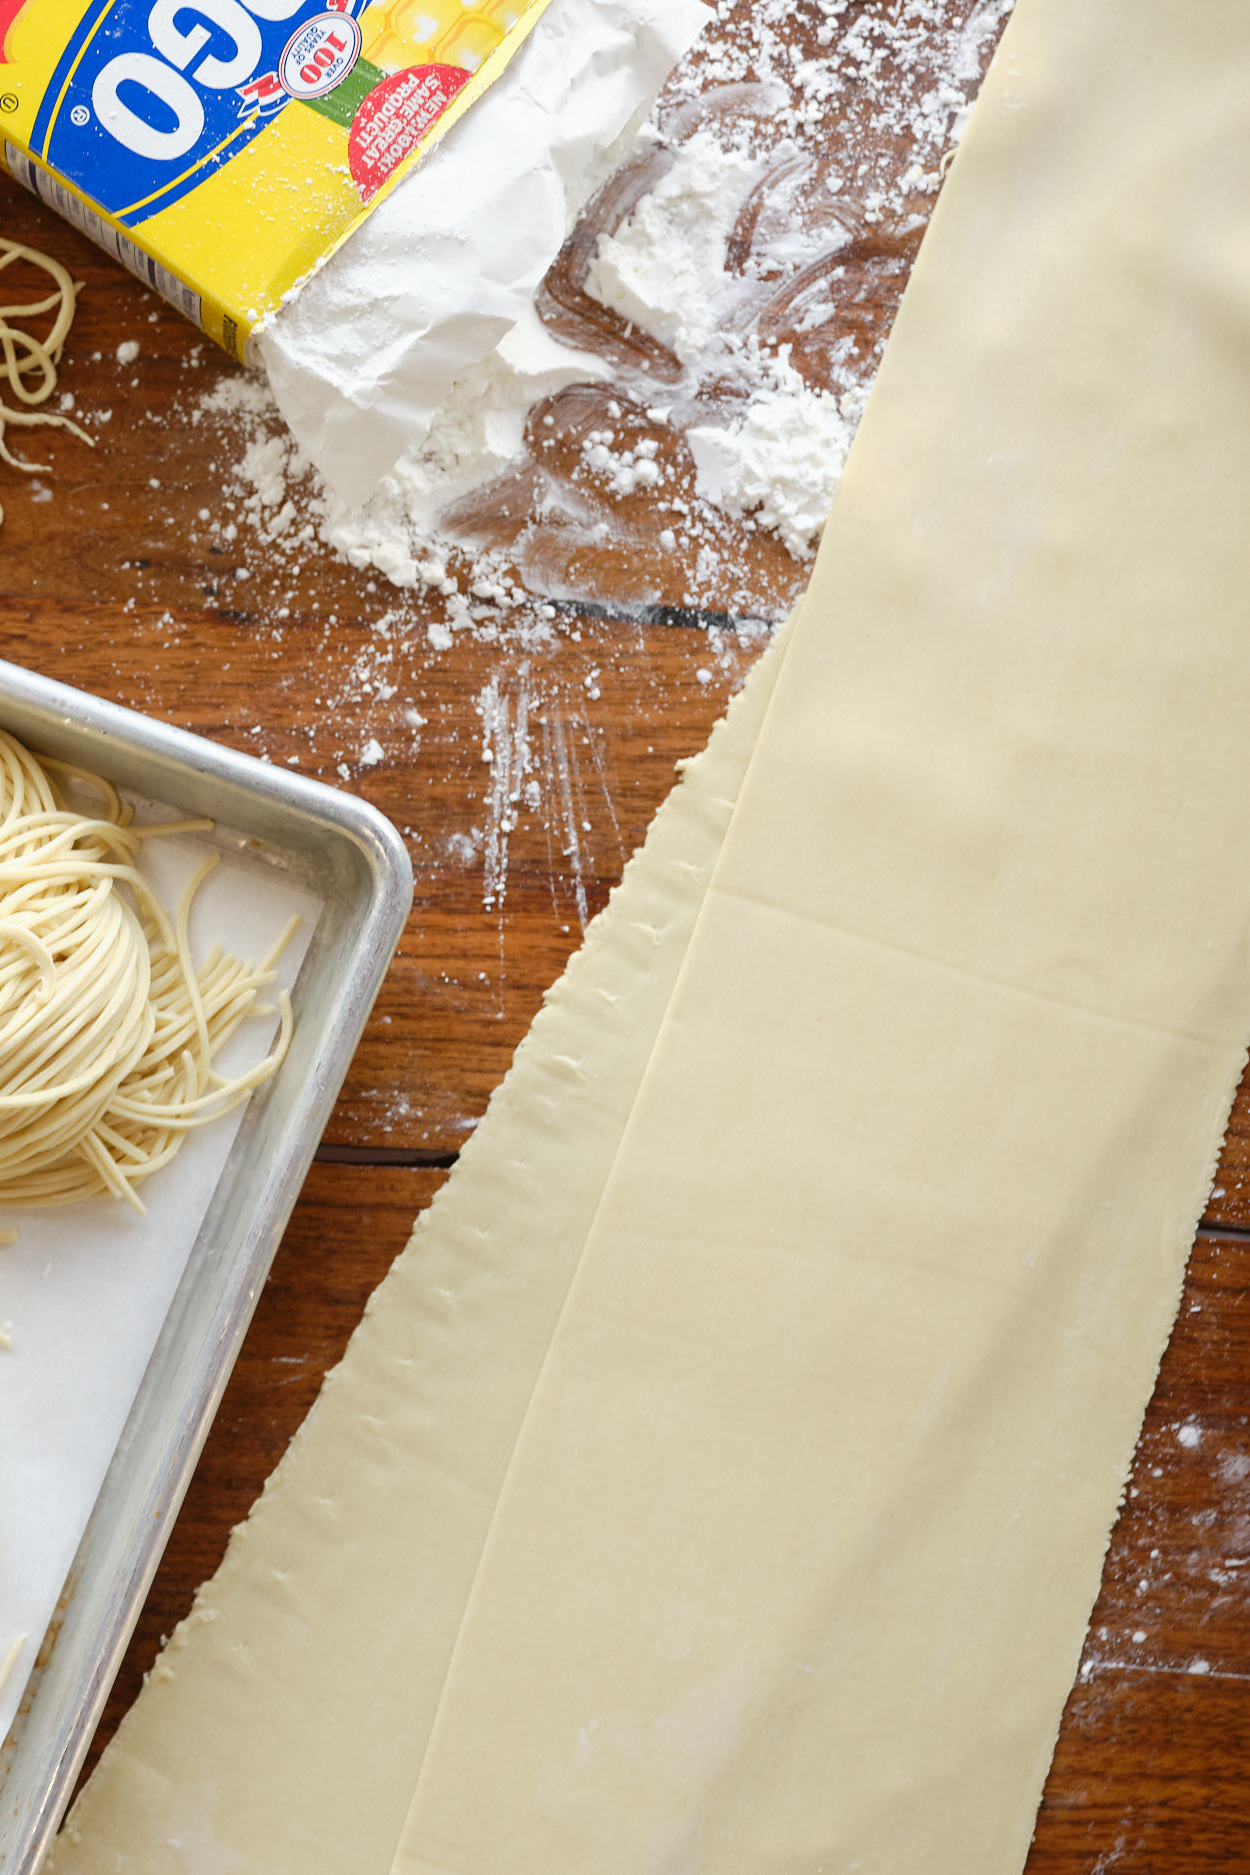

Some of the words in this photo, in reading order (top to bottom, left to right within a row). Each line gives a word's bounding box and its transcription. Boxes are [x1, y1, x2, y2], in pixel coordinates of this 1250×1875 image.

[292, 26, 318, 59] QUALITY
[296, 55, 306, 65] OF
[300, 31, 348, 84] 100
[305, 30, 325, 53] YEARS
[92, 0, 305, 161] GO
[326, 57, 344, 78] OVER
[355, 73, 420, 148] PRODUCT!
[400, 73, 438, 119] SAME
[416, 90, 448, 126] NEW
[362, 117, 404, 168] GREAT
